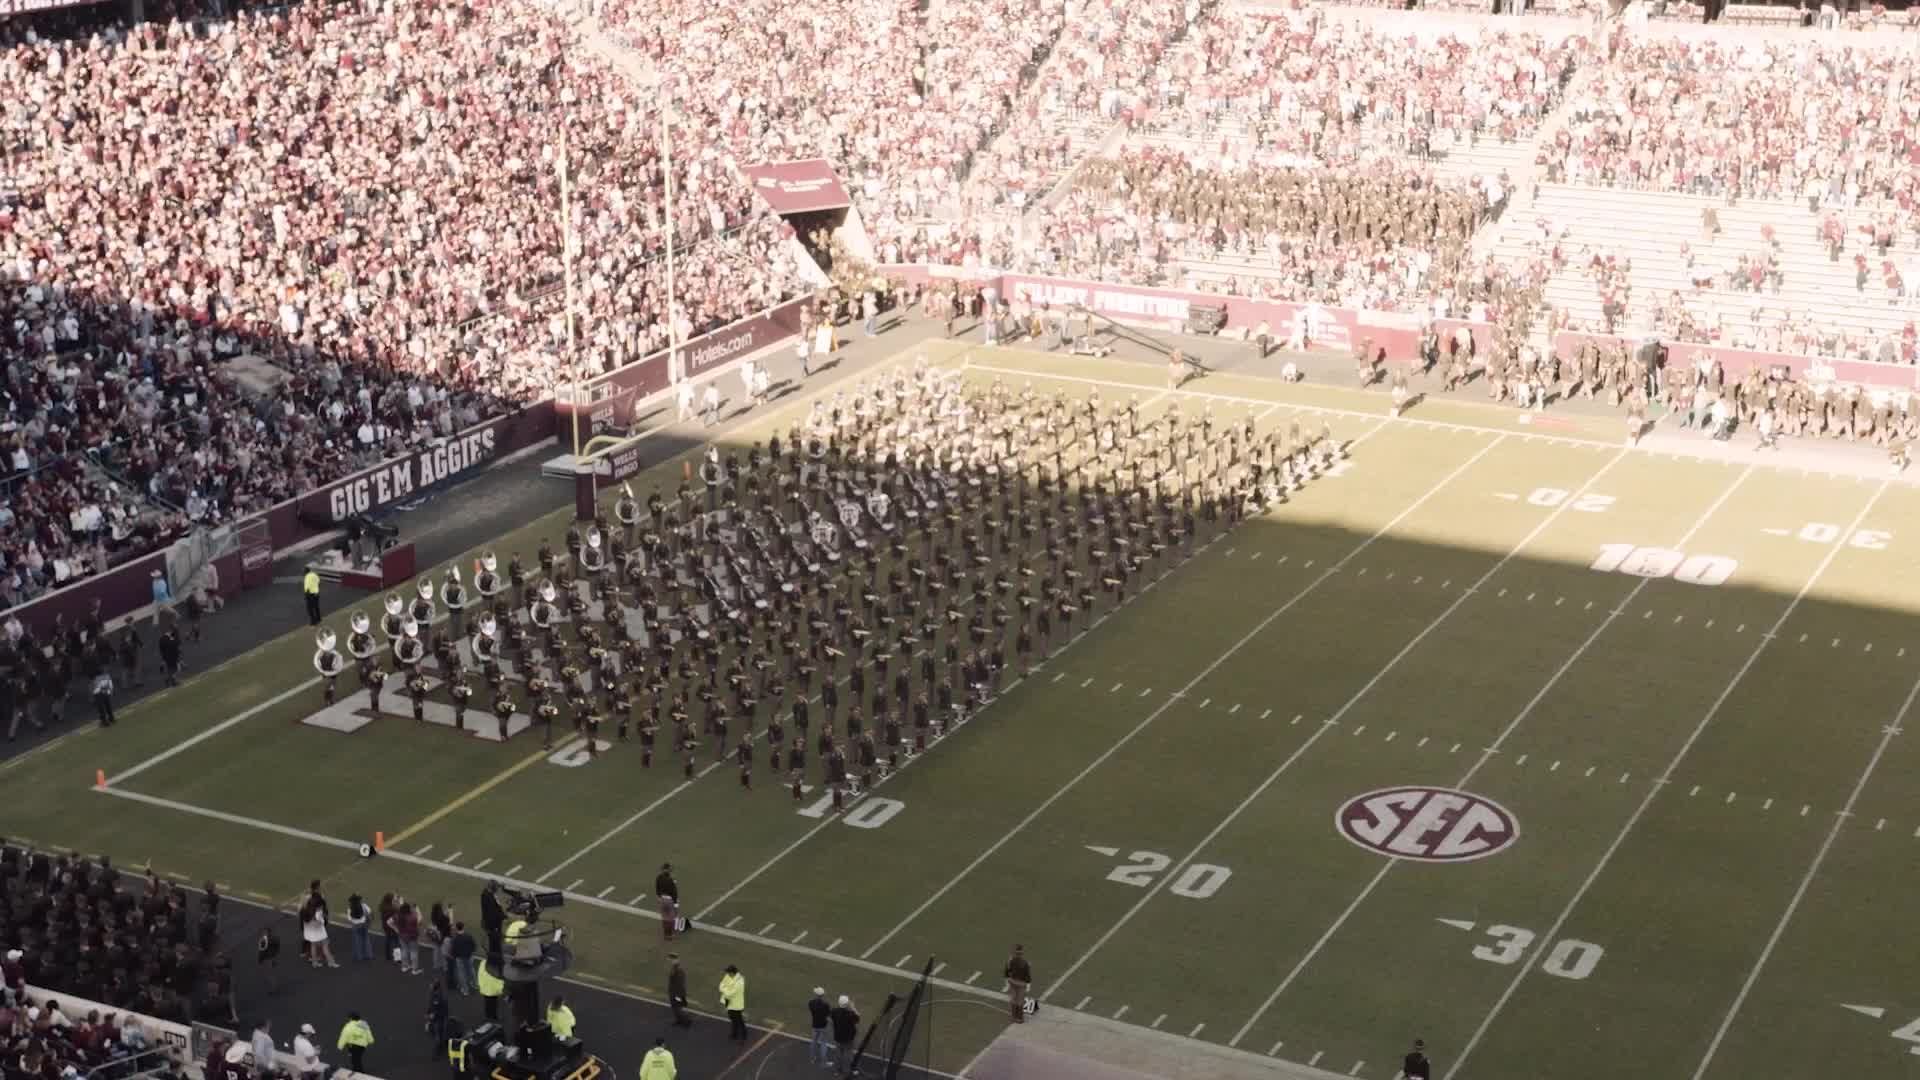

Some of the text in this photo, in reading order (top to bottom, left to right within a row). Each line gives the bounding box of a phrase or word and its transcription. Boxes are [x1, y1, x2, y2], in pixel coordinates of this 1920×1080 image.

[691, 332, 752, 369] Hotels.com
[420, 428, 495, 487] AGGIES
[797, 787, 905, 829] 10
[1349, 791, 1505, 855] SEC
[1106, 851, 1232, 898] 20
[1472, 924, 1604, 980] 30
